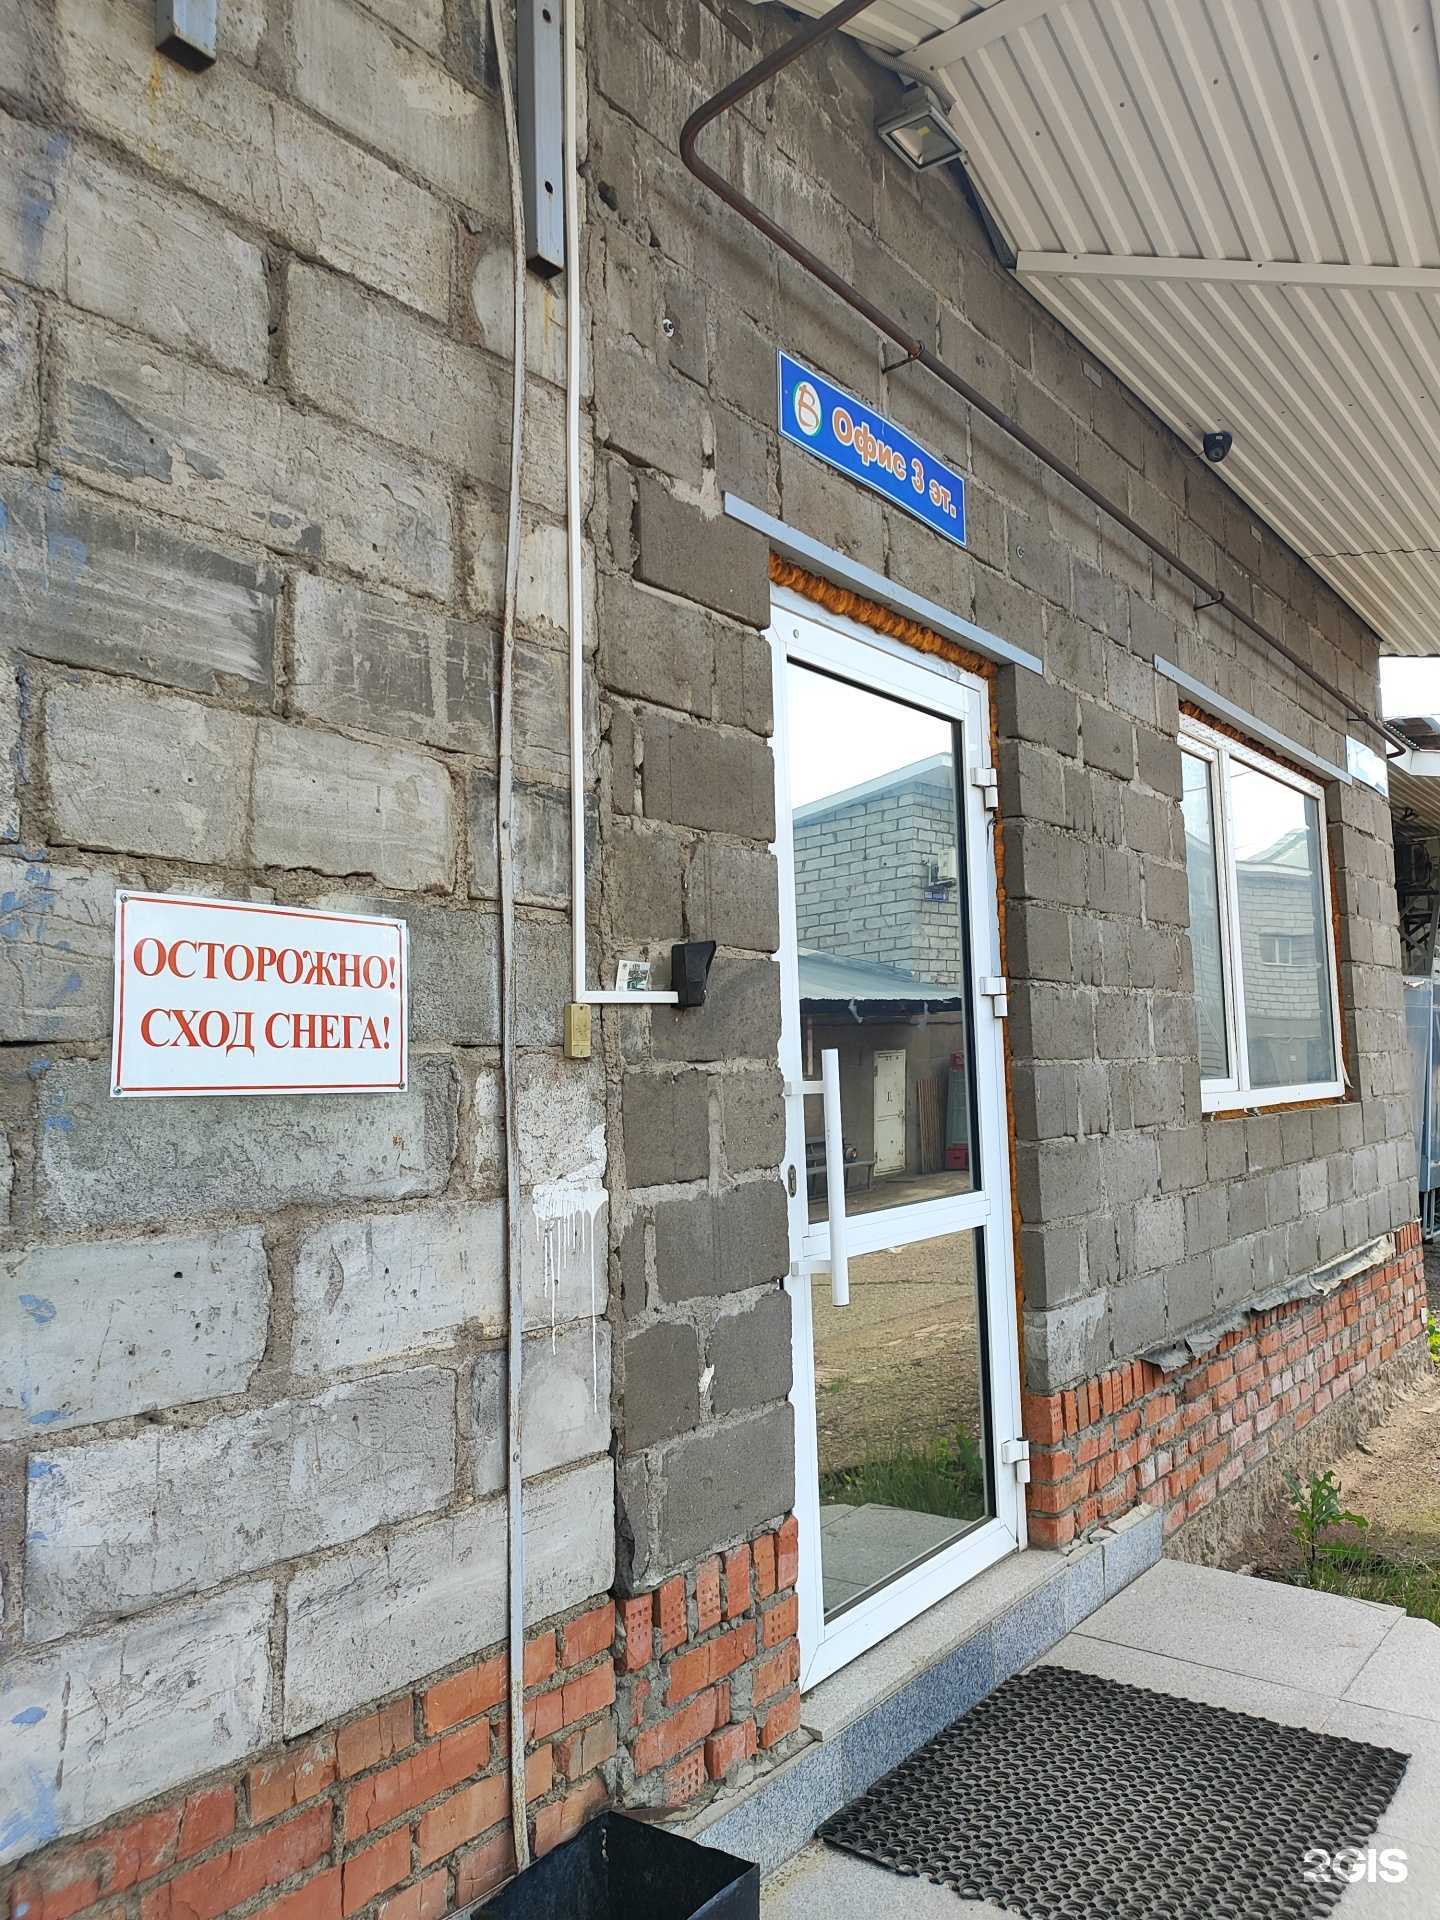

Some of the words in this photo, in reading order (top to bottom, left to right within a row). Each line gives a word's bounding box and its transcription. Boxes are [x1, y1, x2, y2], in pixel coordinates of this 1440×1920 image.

[832, 406, 906, 480] Офис
[911, 458, 925, 494] 3
[929, 479, 957, 519] эт.
[133, 937, 397, 990] ОСТОРОЖНО!
[140, 1008, 255, 1057] СХОД
[264, 1012, 391, 1050] СНЕГА!
